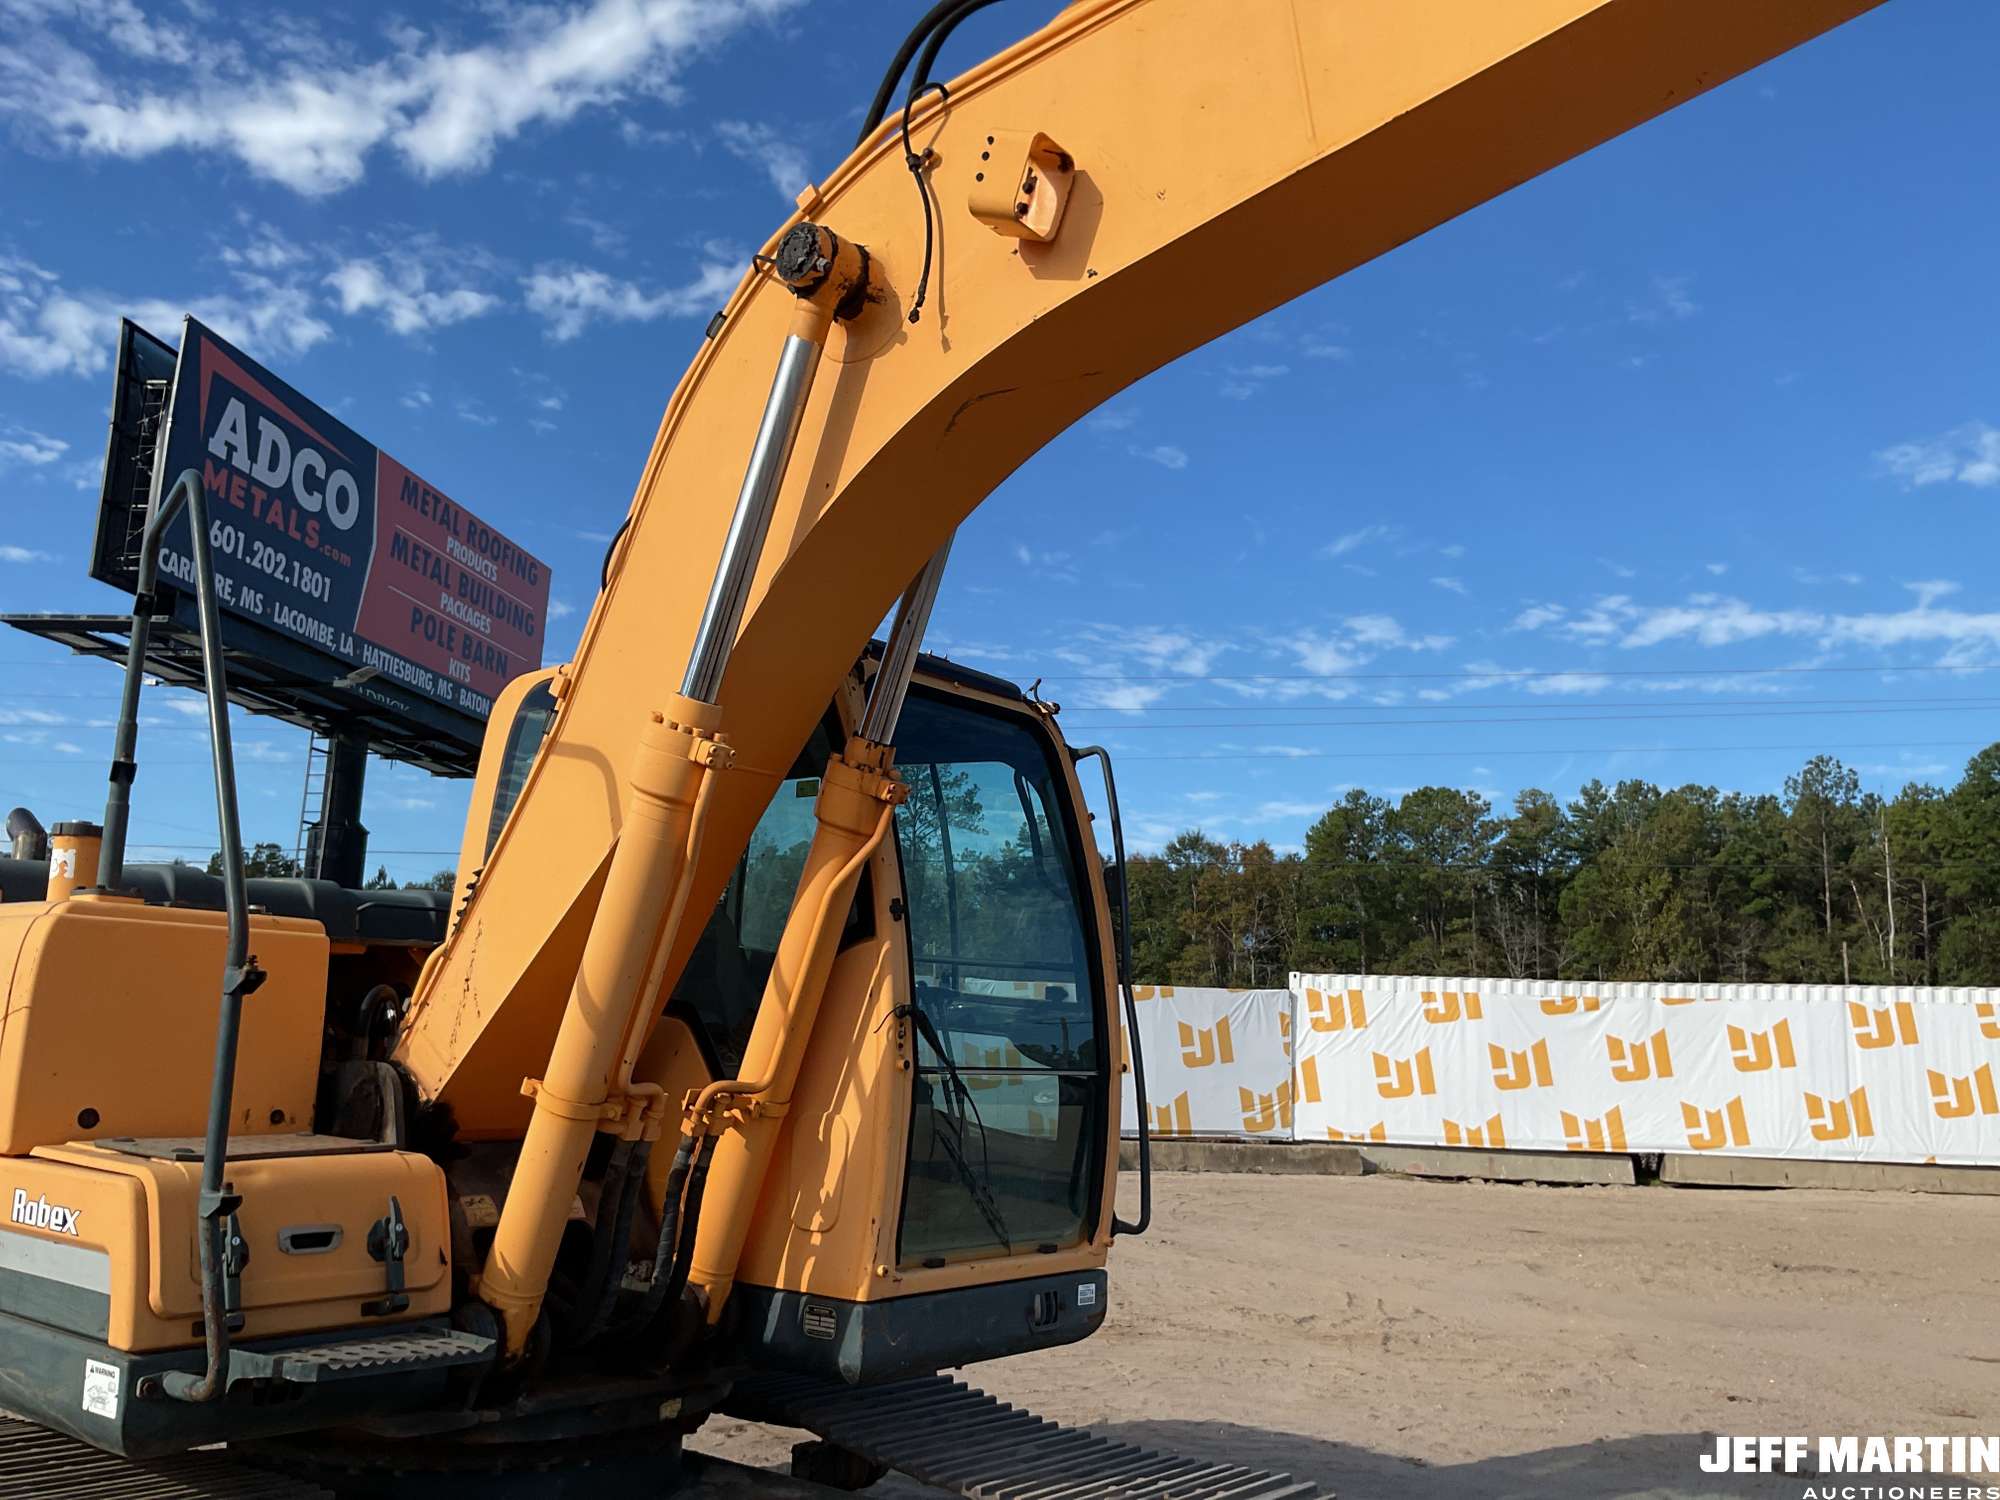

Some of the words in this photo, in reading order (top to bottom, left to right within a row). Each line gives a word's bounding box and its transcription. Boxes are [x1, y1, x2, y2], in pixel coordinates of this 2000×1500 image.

[208, 396, 360, 531] ADCO
[209, 519, 331, 602] 601.202.1801
[400, 475, 461, 537] METAL
[466, 519, 538, 586] ROOFING
[447, 536, 498, 582] PRODUCTS
[390, 531, 451, 589] METAL
[458, 572, 535, 637] BUILDING
[441, 592, 492, 635] PACKAGES
[240, 585, 264, 615] MS
[273, 602, 337, 652] LACOMBE,
[340, 632, 354, 657] LA
[362, 643, 435, 696] HATTIESBURG,
[437, 678, 453, 700] MS
[460, 688, 490, 717] BATON
[411, 606, 457, 653] POLE
[462, 633, 509, 679] BARN
[449, 658, 472, 683] KITS
[11, 1187, 82, 1236] Robex
